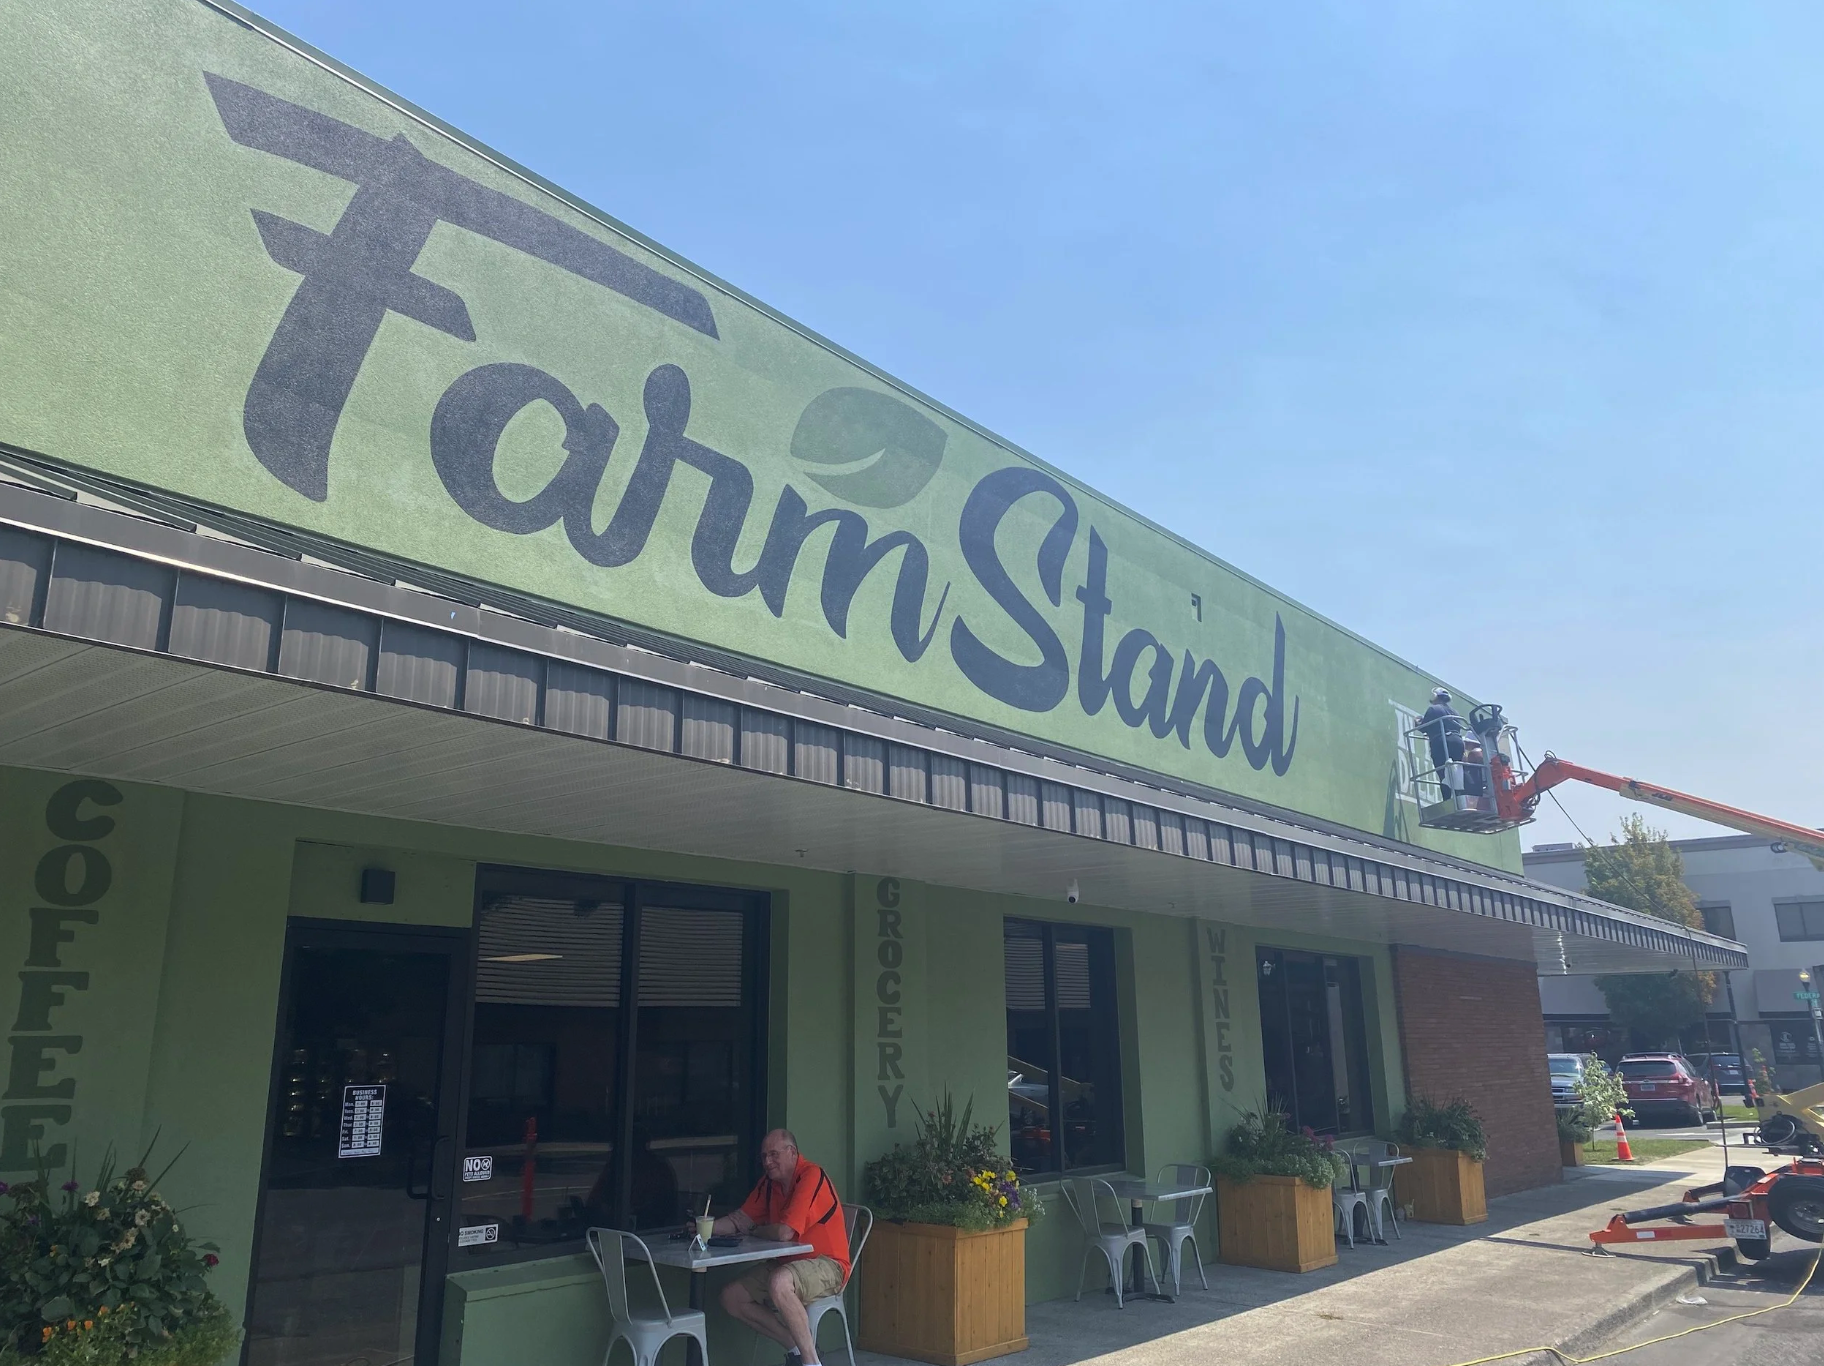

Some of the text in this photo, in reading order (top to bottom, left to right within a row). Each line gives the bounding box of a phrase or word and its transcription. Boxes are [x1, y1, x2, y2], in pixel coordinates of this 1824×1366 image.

[0, 779, 123, 1172] COFFEE
[877, 877, 903, 1128] GROCERY
[1207, 927, 1234, 1092] WINES
[466, 1159, 481, 1172] NO
